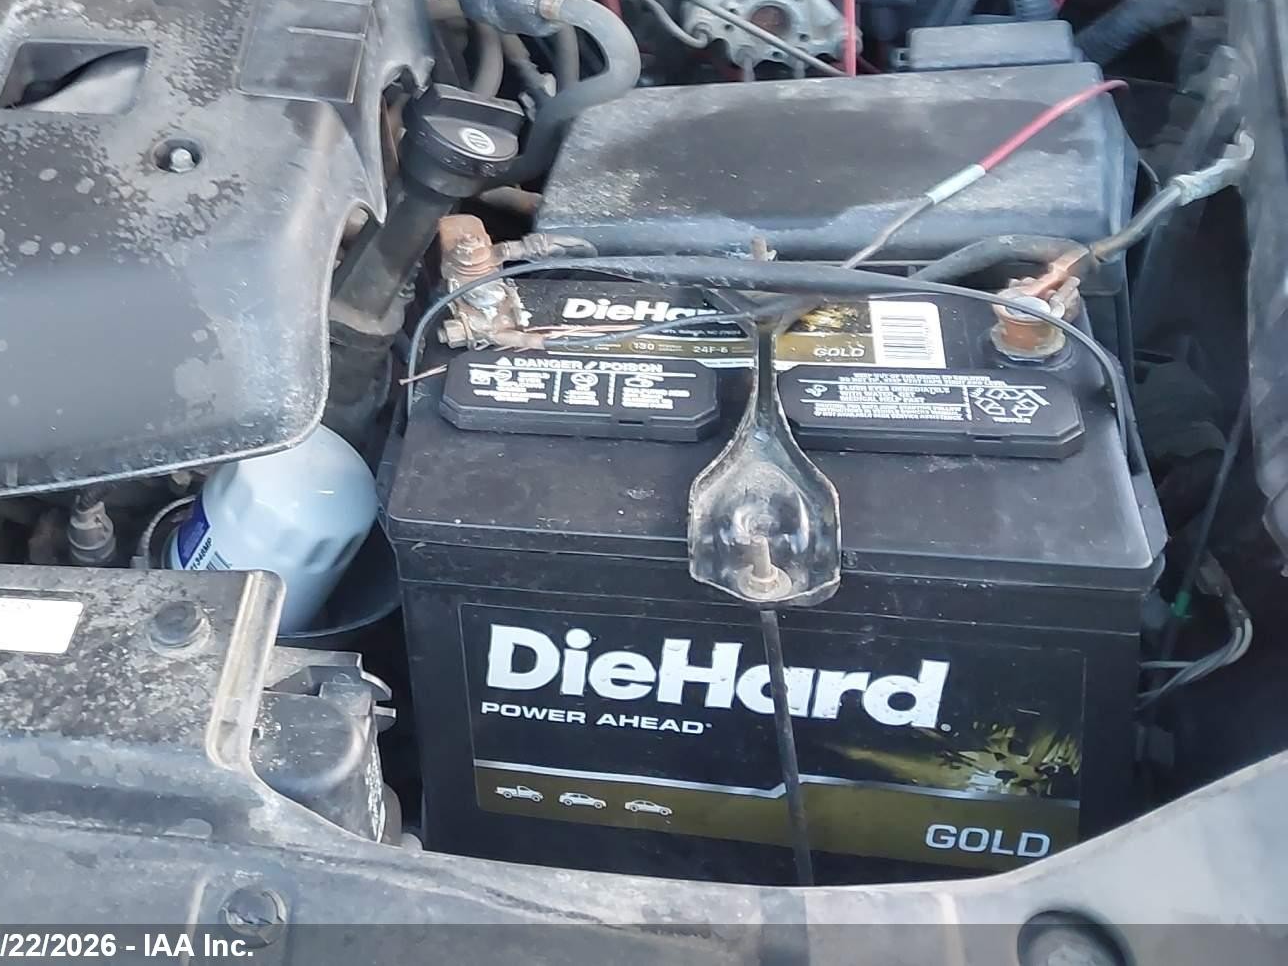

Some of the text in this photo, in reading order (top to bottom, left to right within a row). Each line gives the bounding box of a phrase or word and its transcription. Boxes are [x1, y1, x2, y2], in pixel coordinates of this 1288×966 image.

[514, 357, 583, 370] DANGER
[599, 361, 663, 373] POISON
[813, 347, 864, 357] GOLD
[486, 624, 950, 728] DieHard
[481, 701, 705, 735] POWER AHEAD
[925, 824, 1051, 858] GOLD
